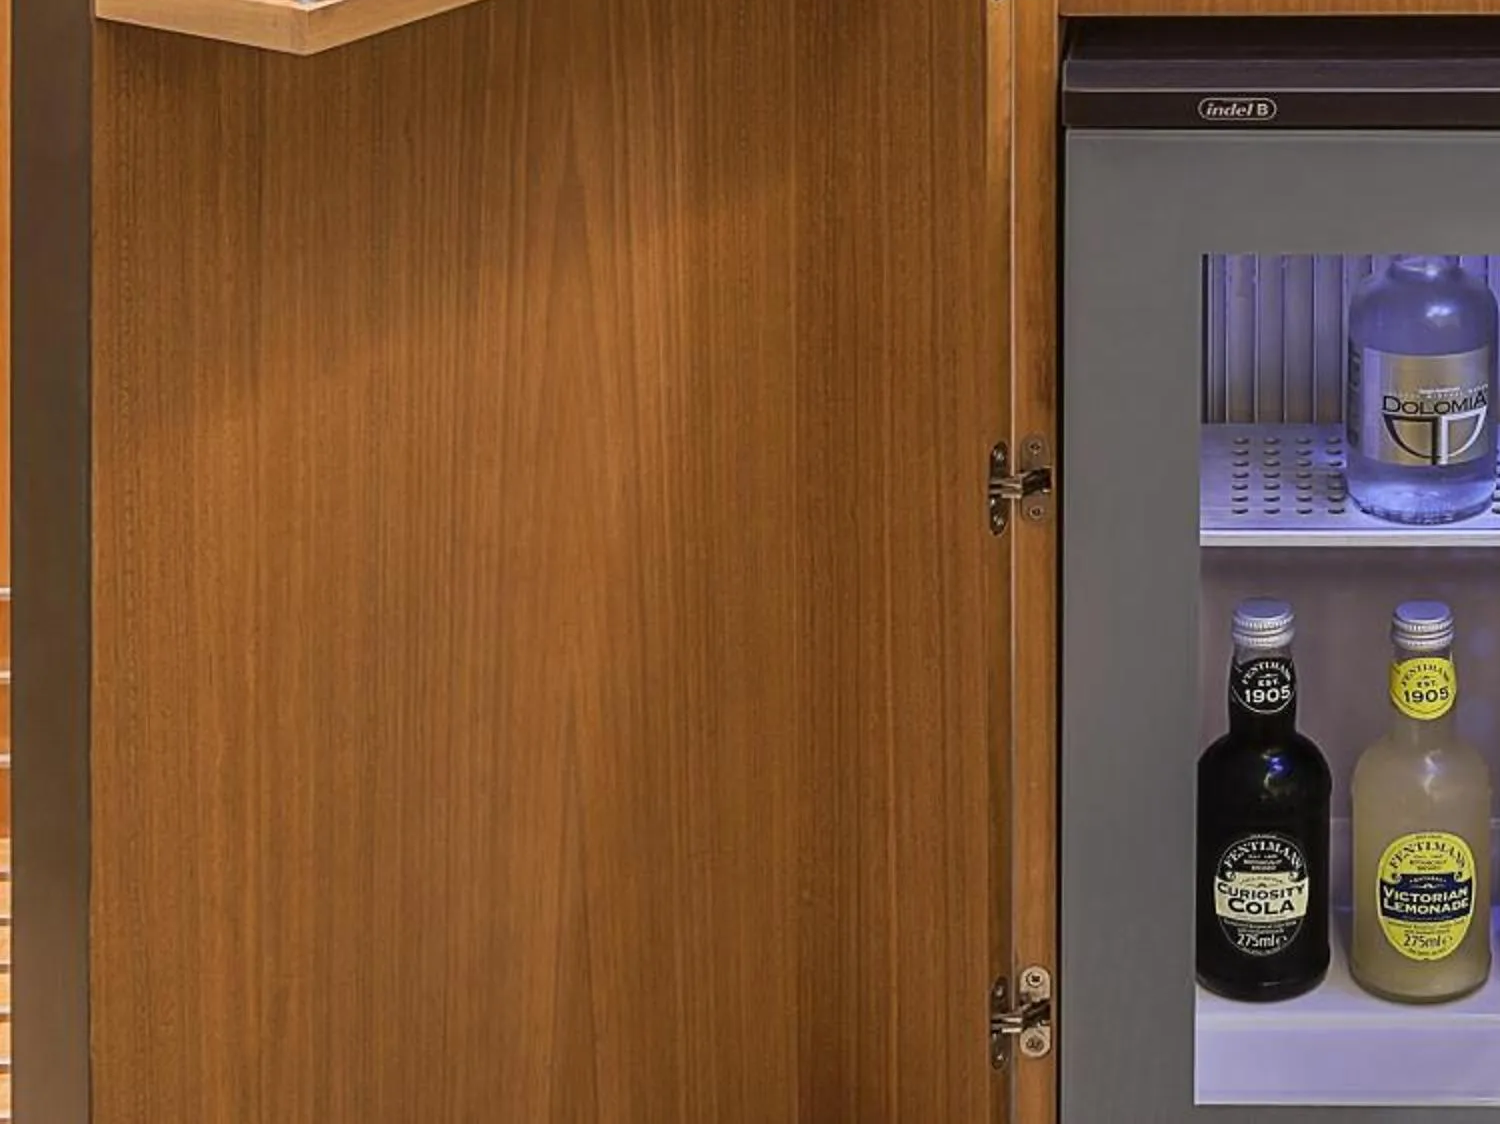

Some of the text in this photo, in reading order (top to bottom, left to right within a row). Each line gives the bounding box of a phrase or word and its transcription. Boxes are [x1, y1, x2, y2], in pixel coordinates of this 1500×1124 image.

[1207, 102, 1269, 117] indel B
[1383, 390, 1488, 415] DOLOMIA
[1244, 685, 1291, 703] 1905
[1404, 686, 1449, 703] 1905
[1217, 882, 1306, 901] CURIOSITY
[1383, 885, 1469, 903] VICTORIAN
[1228, 898, 1295, 915] COLA
[1383, 898, 1469, 915] LEMONADE
